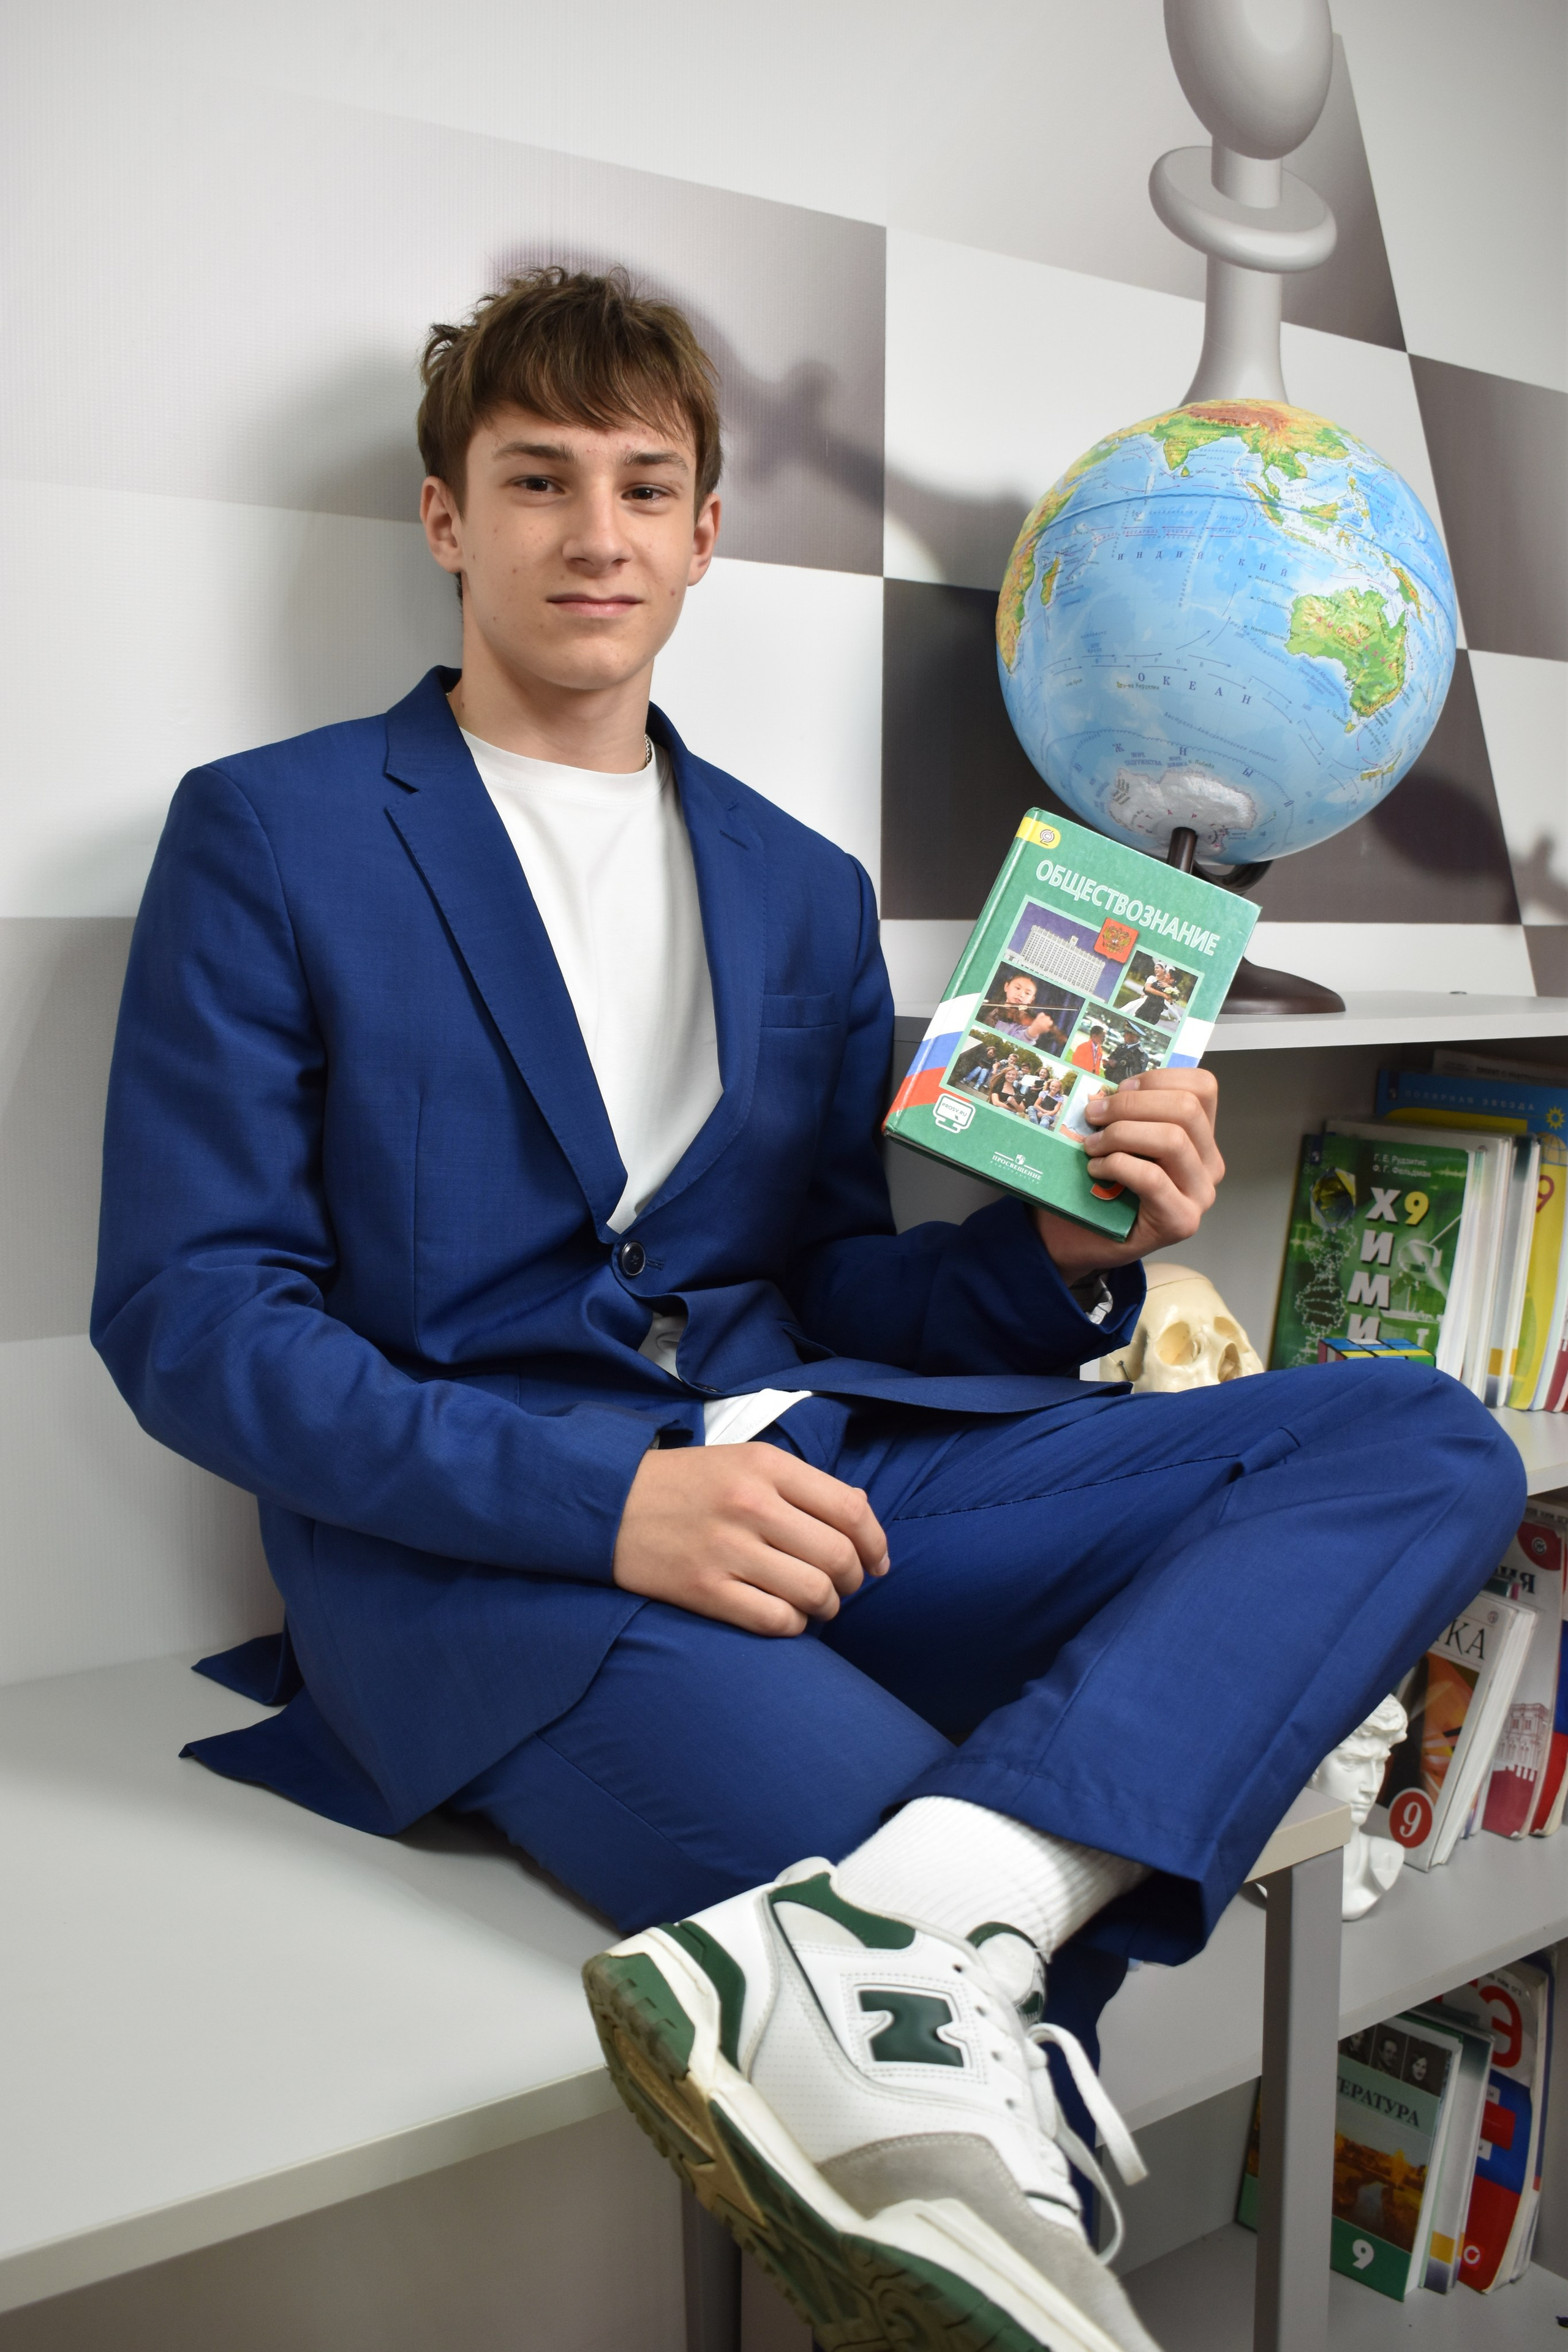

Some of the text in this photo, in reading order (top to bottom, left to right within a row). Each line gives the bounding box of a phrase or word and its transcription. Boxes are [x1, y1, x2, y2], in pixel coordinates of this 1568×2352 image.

[1137, 672, 1252, 705] ОКЕАН
[1036, 859, 1221, 956] ОБЩЕСТВОЗНАНИЕ
[941, 1102, 967, 1117] PROSV.RU
[1482, 1098, 1534, 1111] ЗВЕЗДА
[992, 1155, 1042, 1180] ПРОСВЕЩЕНИЕ
[1392, 1166, 1431, 1178] Фельдман
[1404, 1191, 1430, 1226] 9
[1536, 1175, 1555, 1213] 9
[1399, 1801, 1422, 1838] 9
[1338, 2076, 1420, 2128] ЕРАТУРА
[1352, 2239, 1375, 2270] 9
